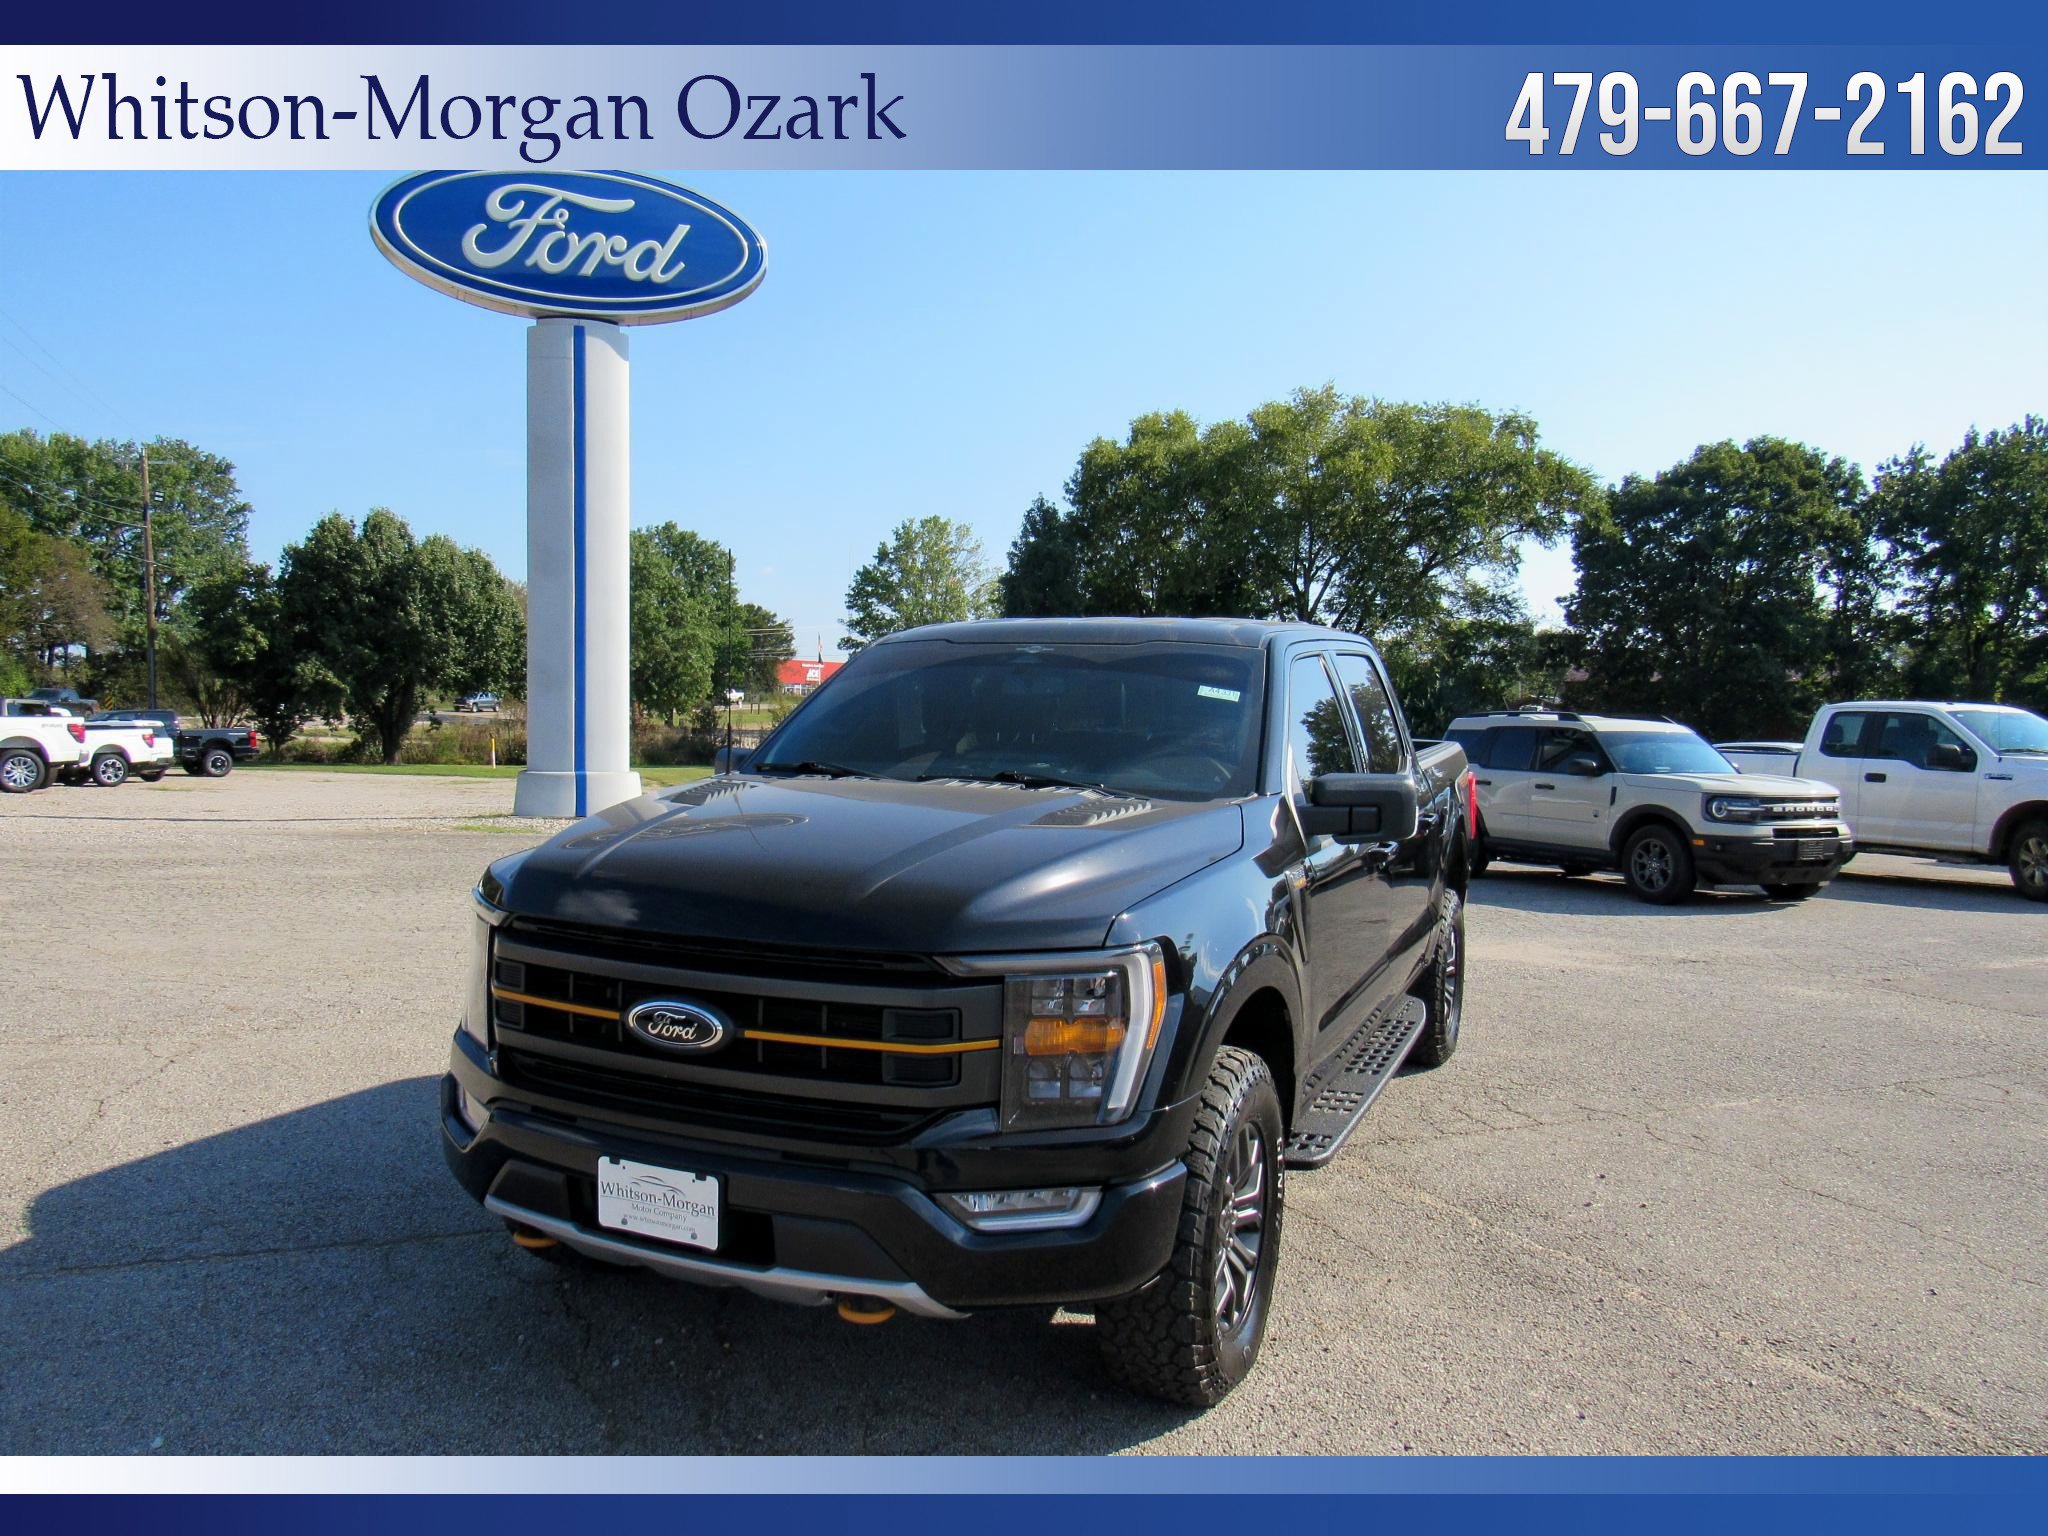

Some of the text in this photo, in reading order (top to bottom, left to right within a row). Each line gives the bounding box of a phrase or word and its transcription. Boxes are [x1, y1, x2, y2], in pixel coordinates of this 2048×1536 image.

[461, 182, 691, 285] Ford
[647, 1010, 698, 1040] Ford
[600, 1180, 715, 1217] Whitson-Morgan
[631, 1202, 687, 1222] Motor Company
